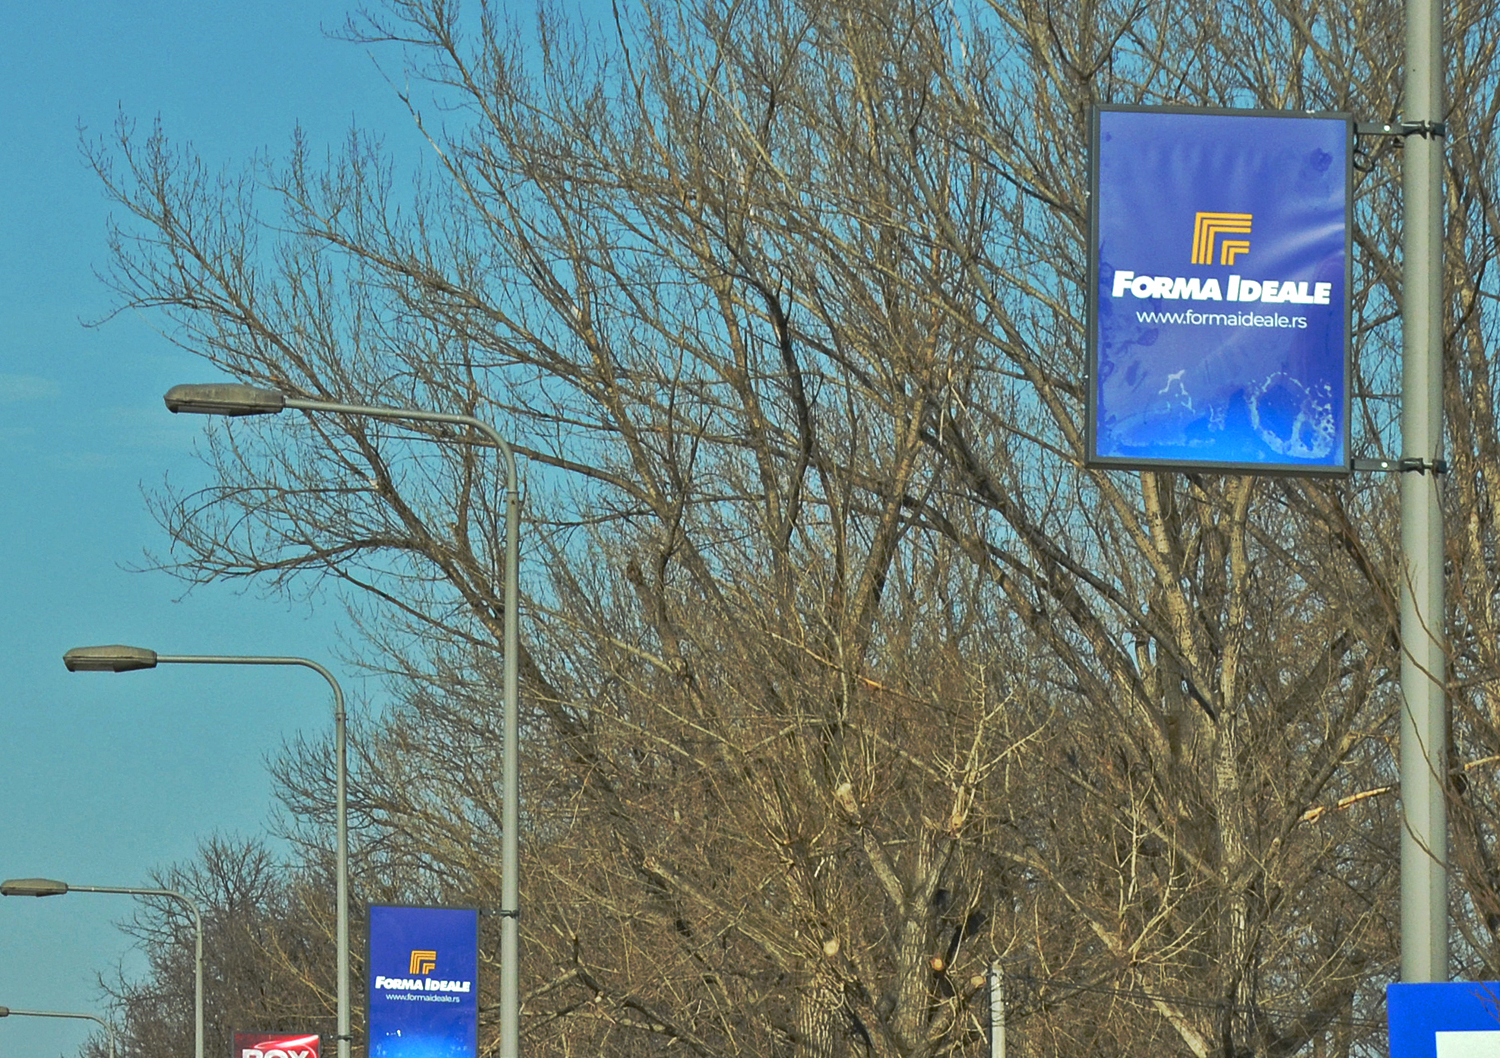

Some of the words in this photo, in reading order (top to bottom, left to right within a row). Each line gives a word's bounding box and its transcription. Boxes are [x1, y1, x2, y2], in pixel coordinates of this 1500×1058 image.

[1112, 271, 1222, 301] FORMA
[1227, 274, 1332, 304] IDEALE
[1136, 308, 1308, 329] www.formaideale.rs
[375, 976, 423, 991] FORMA
[425, 978, 470, 992] IDEALE
[385, 993, 460, 1003] www.formaideale.rs
